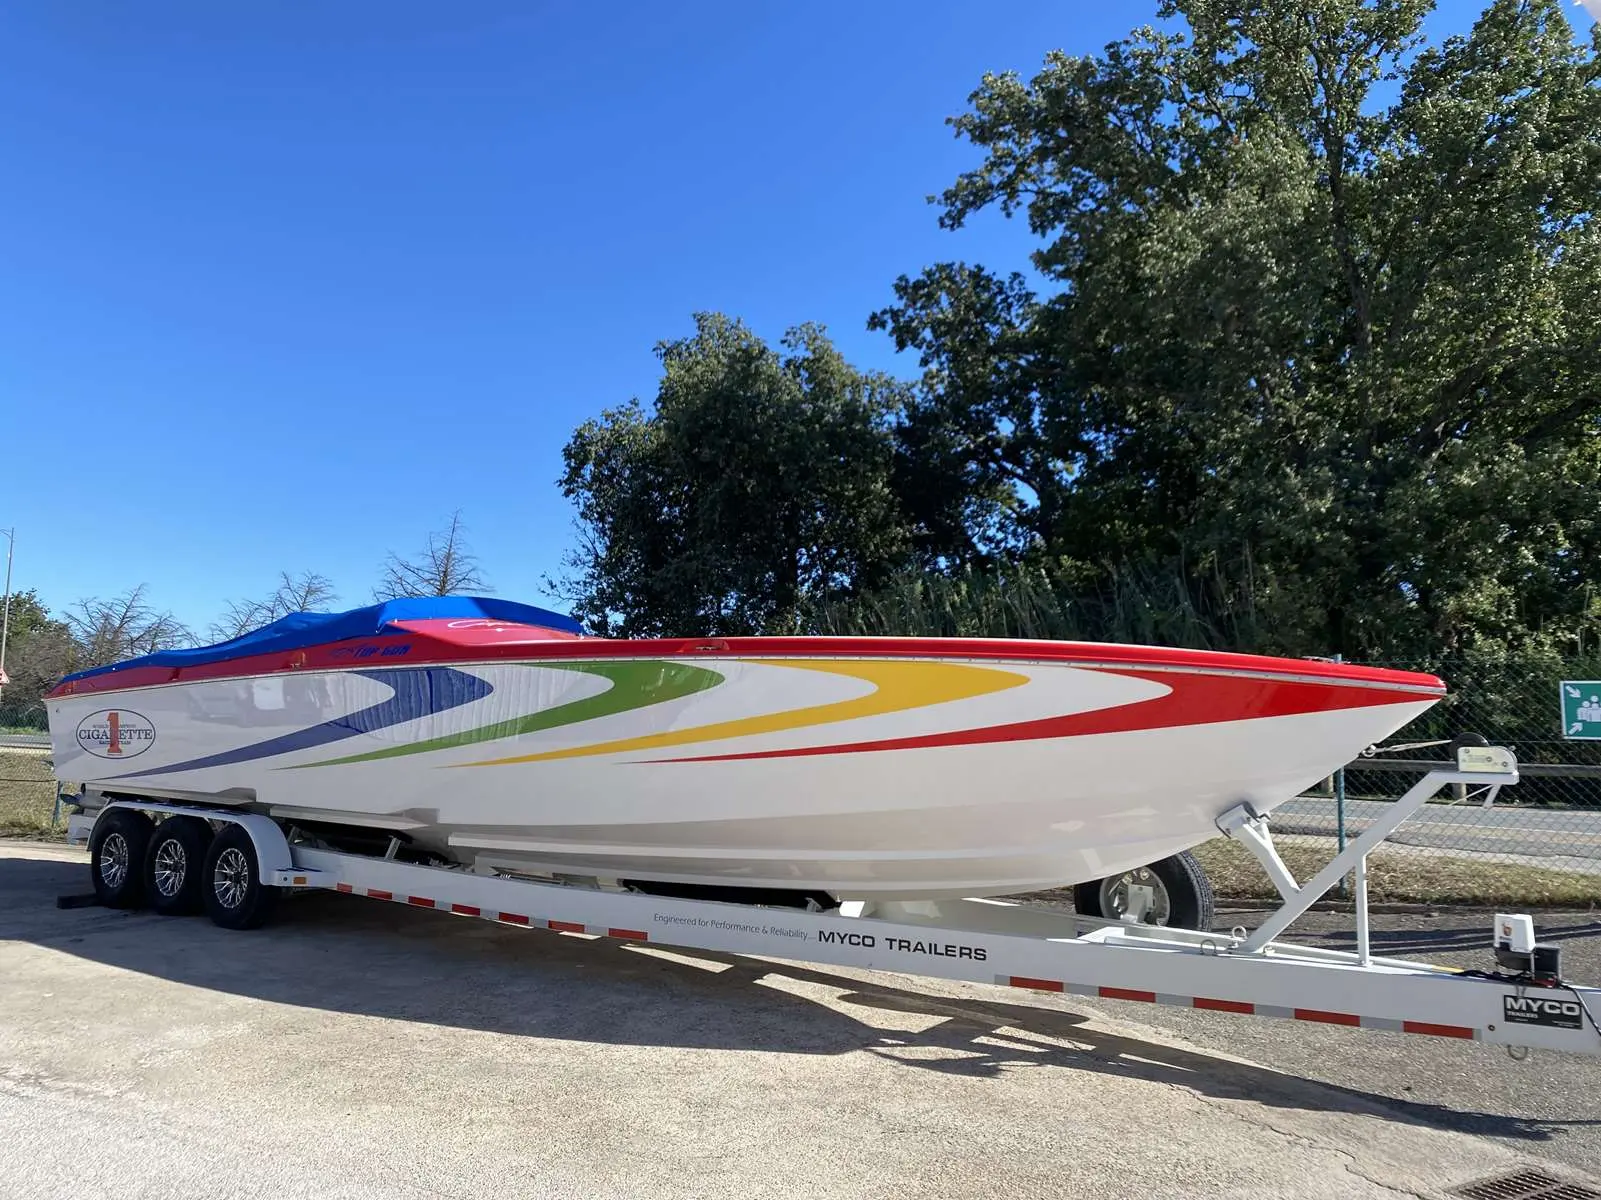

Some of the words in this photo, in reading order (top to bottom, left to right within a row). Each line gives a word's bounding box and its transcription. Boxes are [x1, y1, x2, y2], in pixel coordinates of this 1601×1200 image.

[79, 729, 153, 740] CIGAETTE
[107, 712, 122, 756] 1
[654, 913, 697, 926] Engineered
[698, 917, 710, 927] for
[711, 919, 760, 934] Performance
[762, 926, 769, 935] &
[818, 930, 876, 948] MYCO
[885, 937, 987, 961] TRAILERS
[1505, 997, 1580, 1016] MYCO
